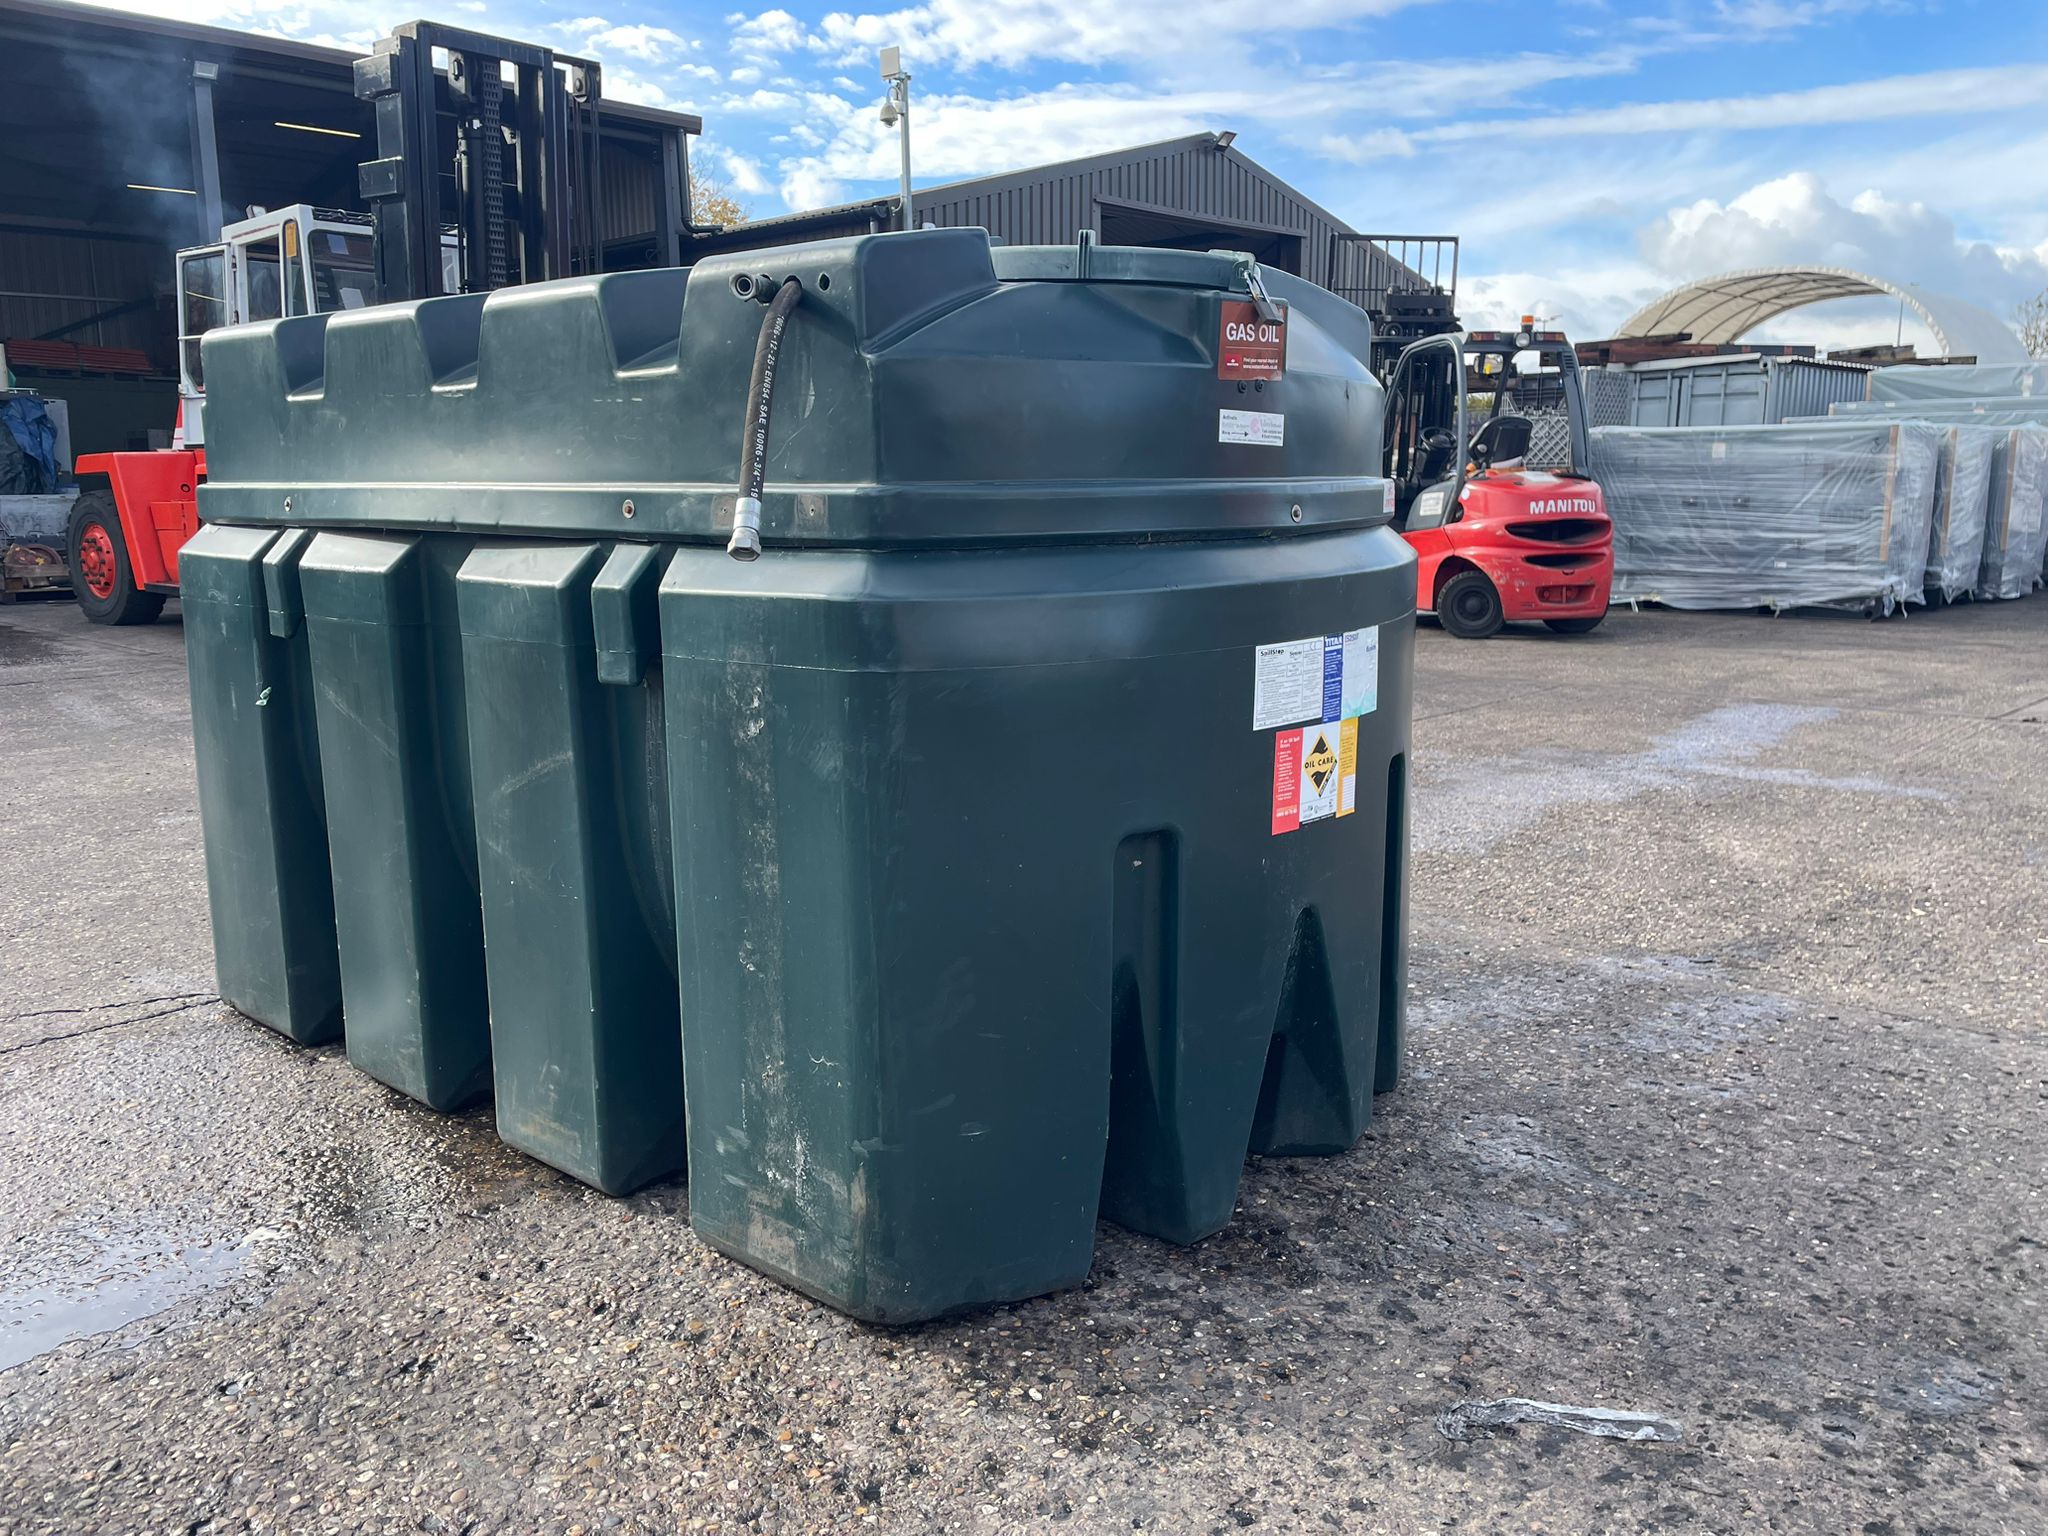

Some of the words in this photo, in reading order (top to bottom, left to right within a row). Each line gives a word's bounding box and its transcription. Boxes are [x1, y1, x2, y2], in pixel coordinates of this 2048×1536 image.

[1226, 322, 1255, 342] GAS
[1258, 324, 1280, 343] OIL
[1529, 498, 1596, 515] MANITOU
[1304, 760, 1316, 769] OIL
[1317, 756, 1334, 767] CARE
